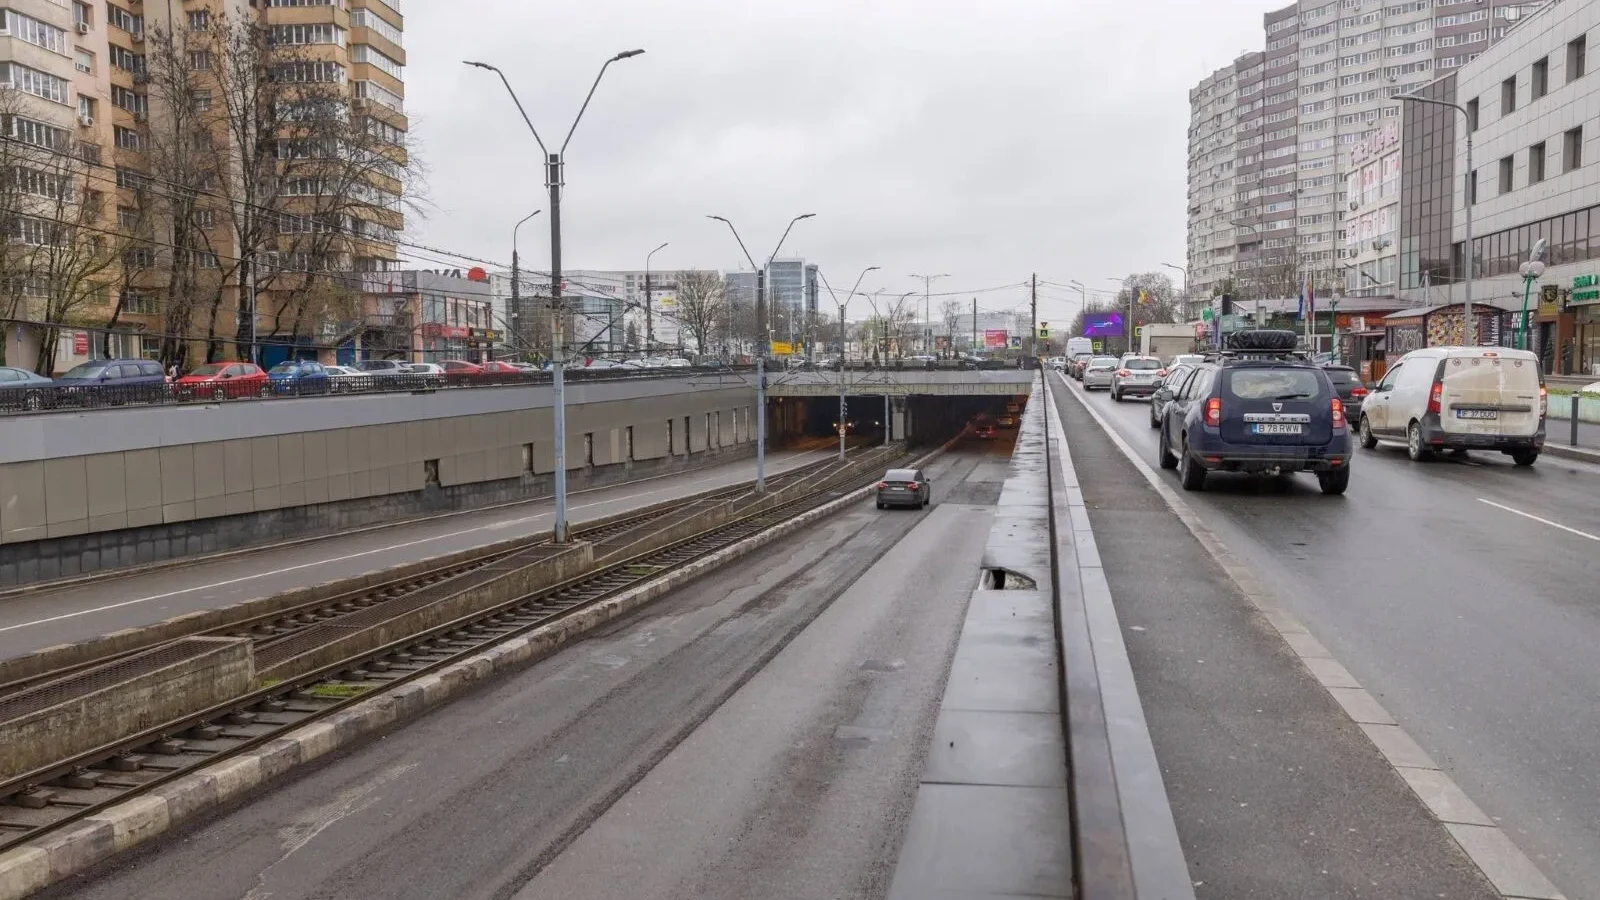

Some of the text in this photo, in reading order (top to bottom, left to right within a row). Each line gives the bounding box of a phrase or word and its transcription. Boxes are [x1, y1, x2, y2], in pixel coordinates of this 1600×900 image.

[1259, 424, 1299, 432] B 78 RWW
